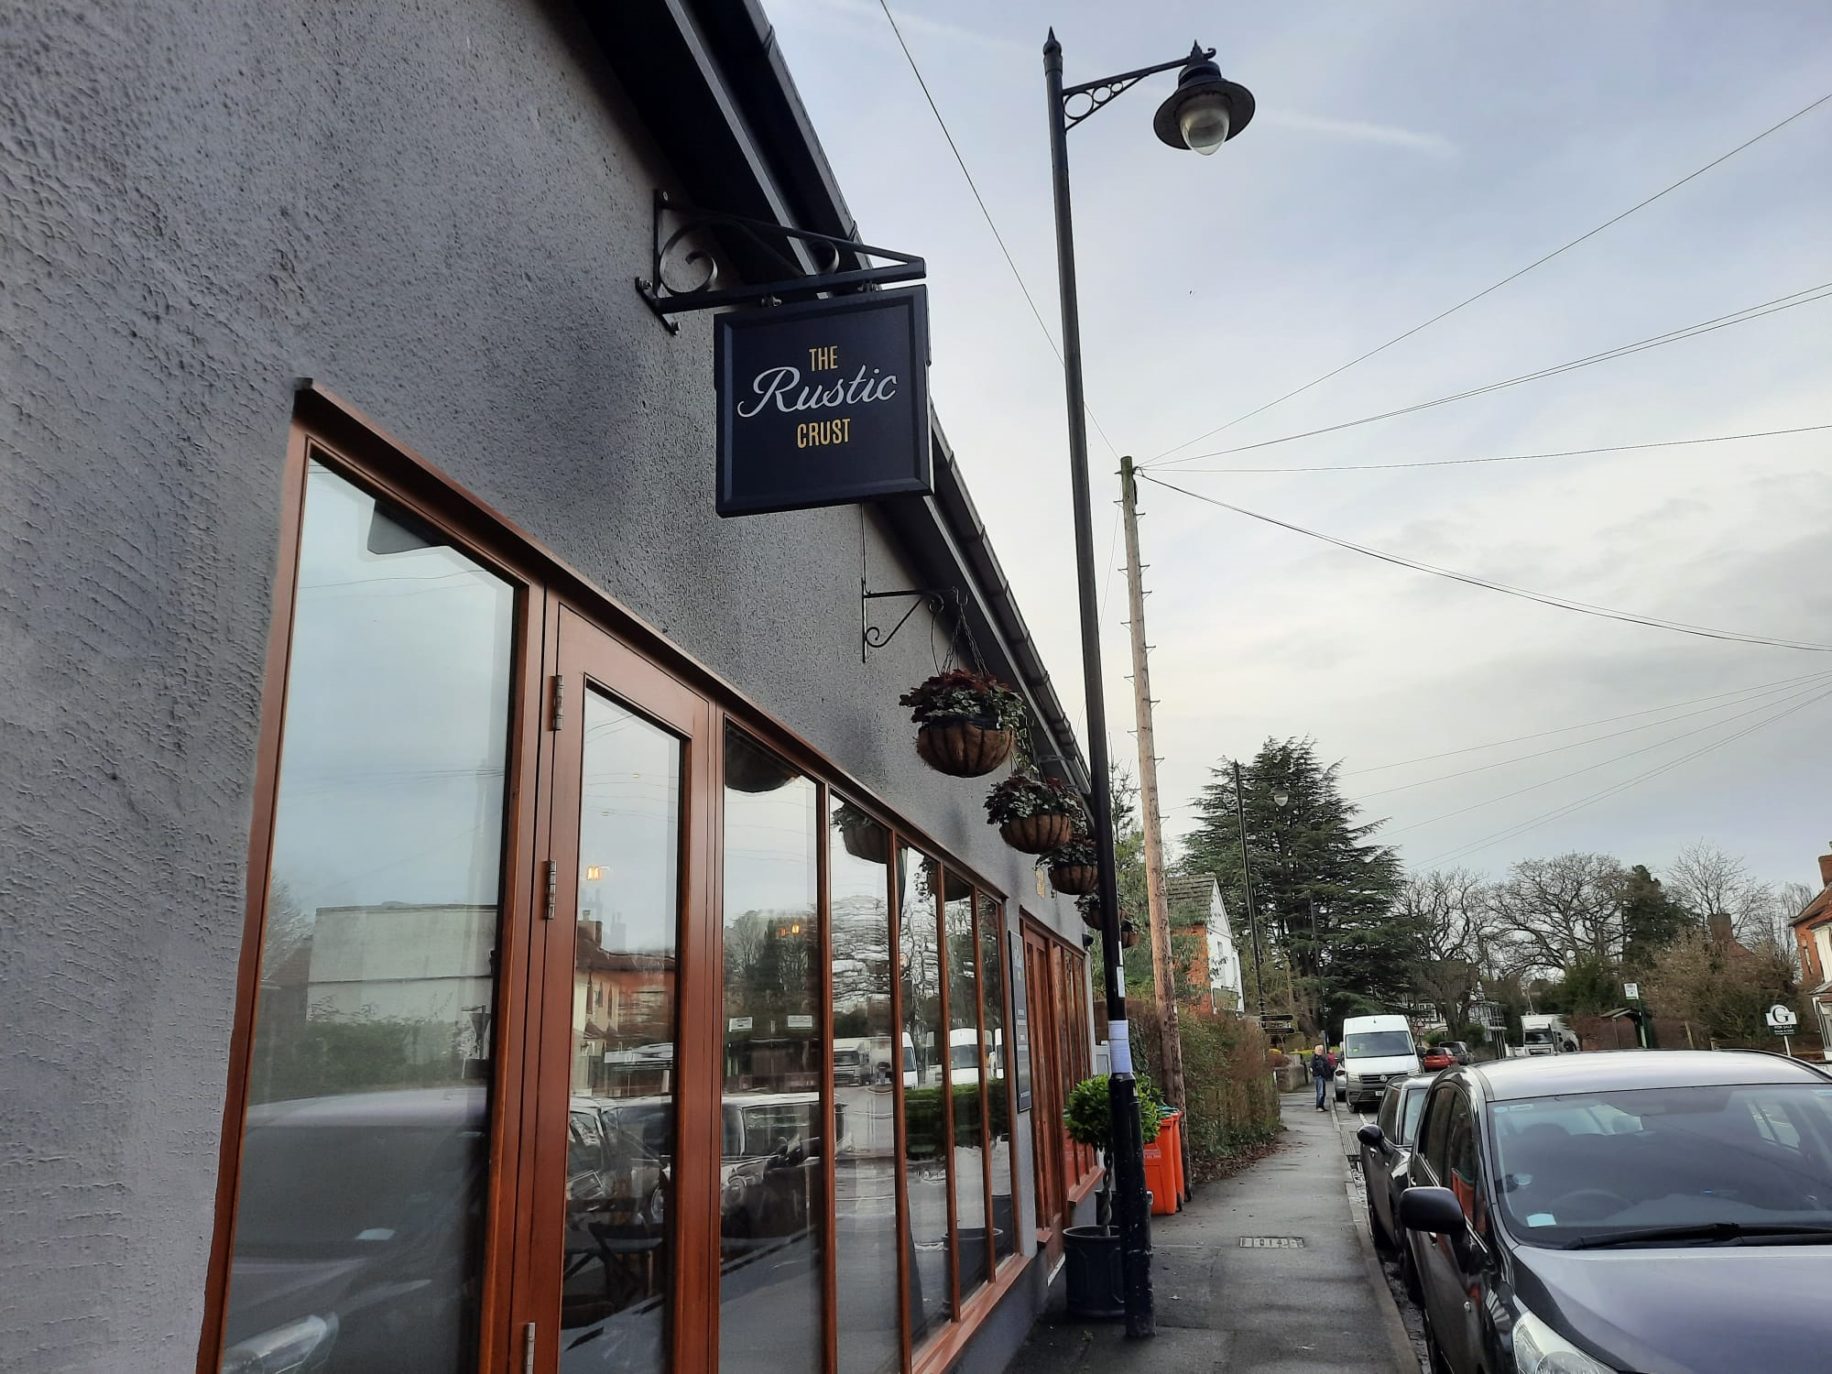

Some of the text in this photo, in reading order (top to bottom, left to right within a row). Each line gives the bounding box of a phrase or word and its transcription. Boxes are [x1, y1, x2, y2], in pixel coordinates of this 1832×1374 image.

[809, 345, 838, 372] THE
[737, 364, 897, 418] Rustic
[797, 418, 851, 449] CRUST
